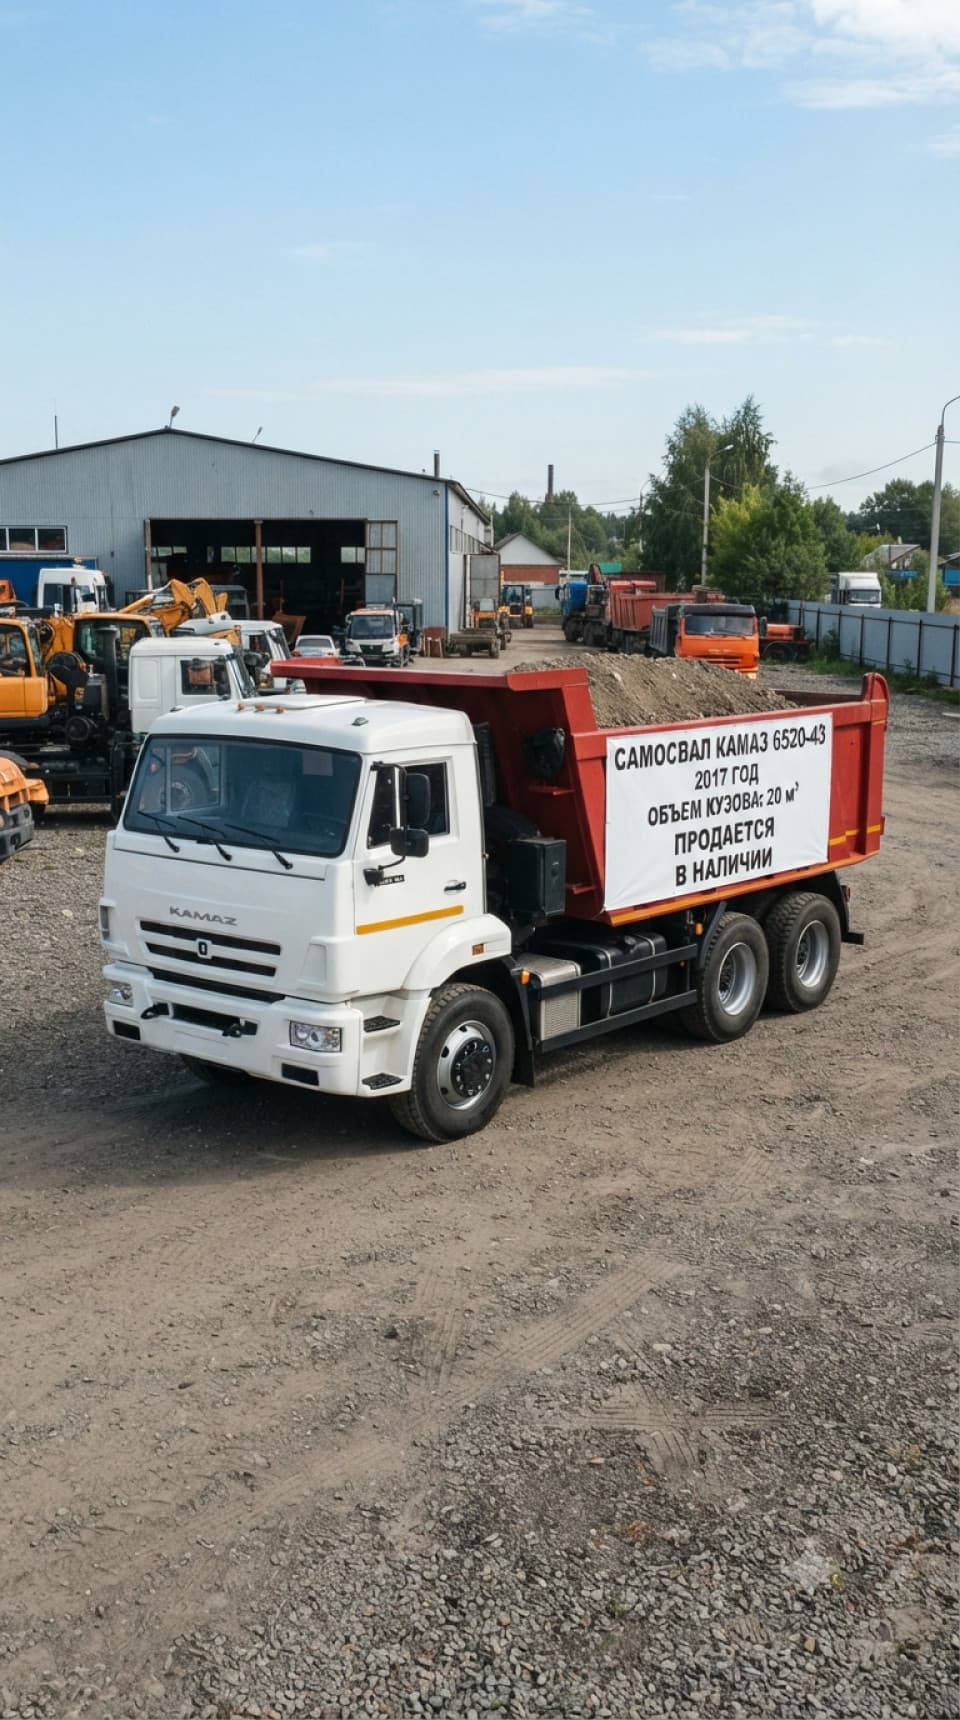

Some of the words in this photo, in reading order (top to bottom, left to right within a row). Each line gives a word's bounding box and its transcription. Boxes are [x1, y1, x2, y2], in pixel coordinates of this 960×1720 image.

[614, 737, 711, 770] САМОСВАЛ
[716, 732, 768, 759] КАМАЗ
[773, 723, 826, 750] 6520-43
[695, 768, 728, 790] 2017
[732, 763, 759, 785] ГОД
[648, 799, 702, 826] ОБЪЕМ
[706, 790, 764, 818] КУЗОВА:
[767, 787, 781, 806] 20
[674, 817, 775, 855] ПРОДАЕТСЯ
[675, 865, 687, 886] В
[693, 847, 772, 883] НАЛИЧИИ
[169, 906, 237, 926] KAMAZ
